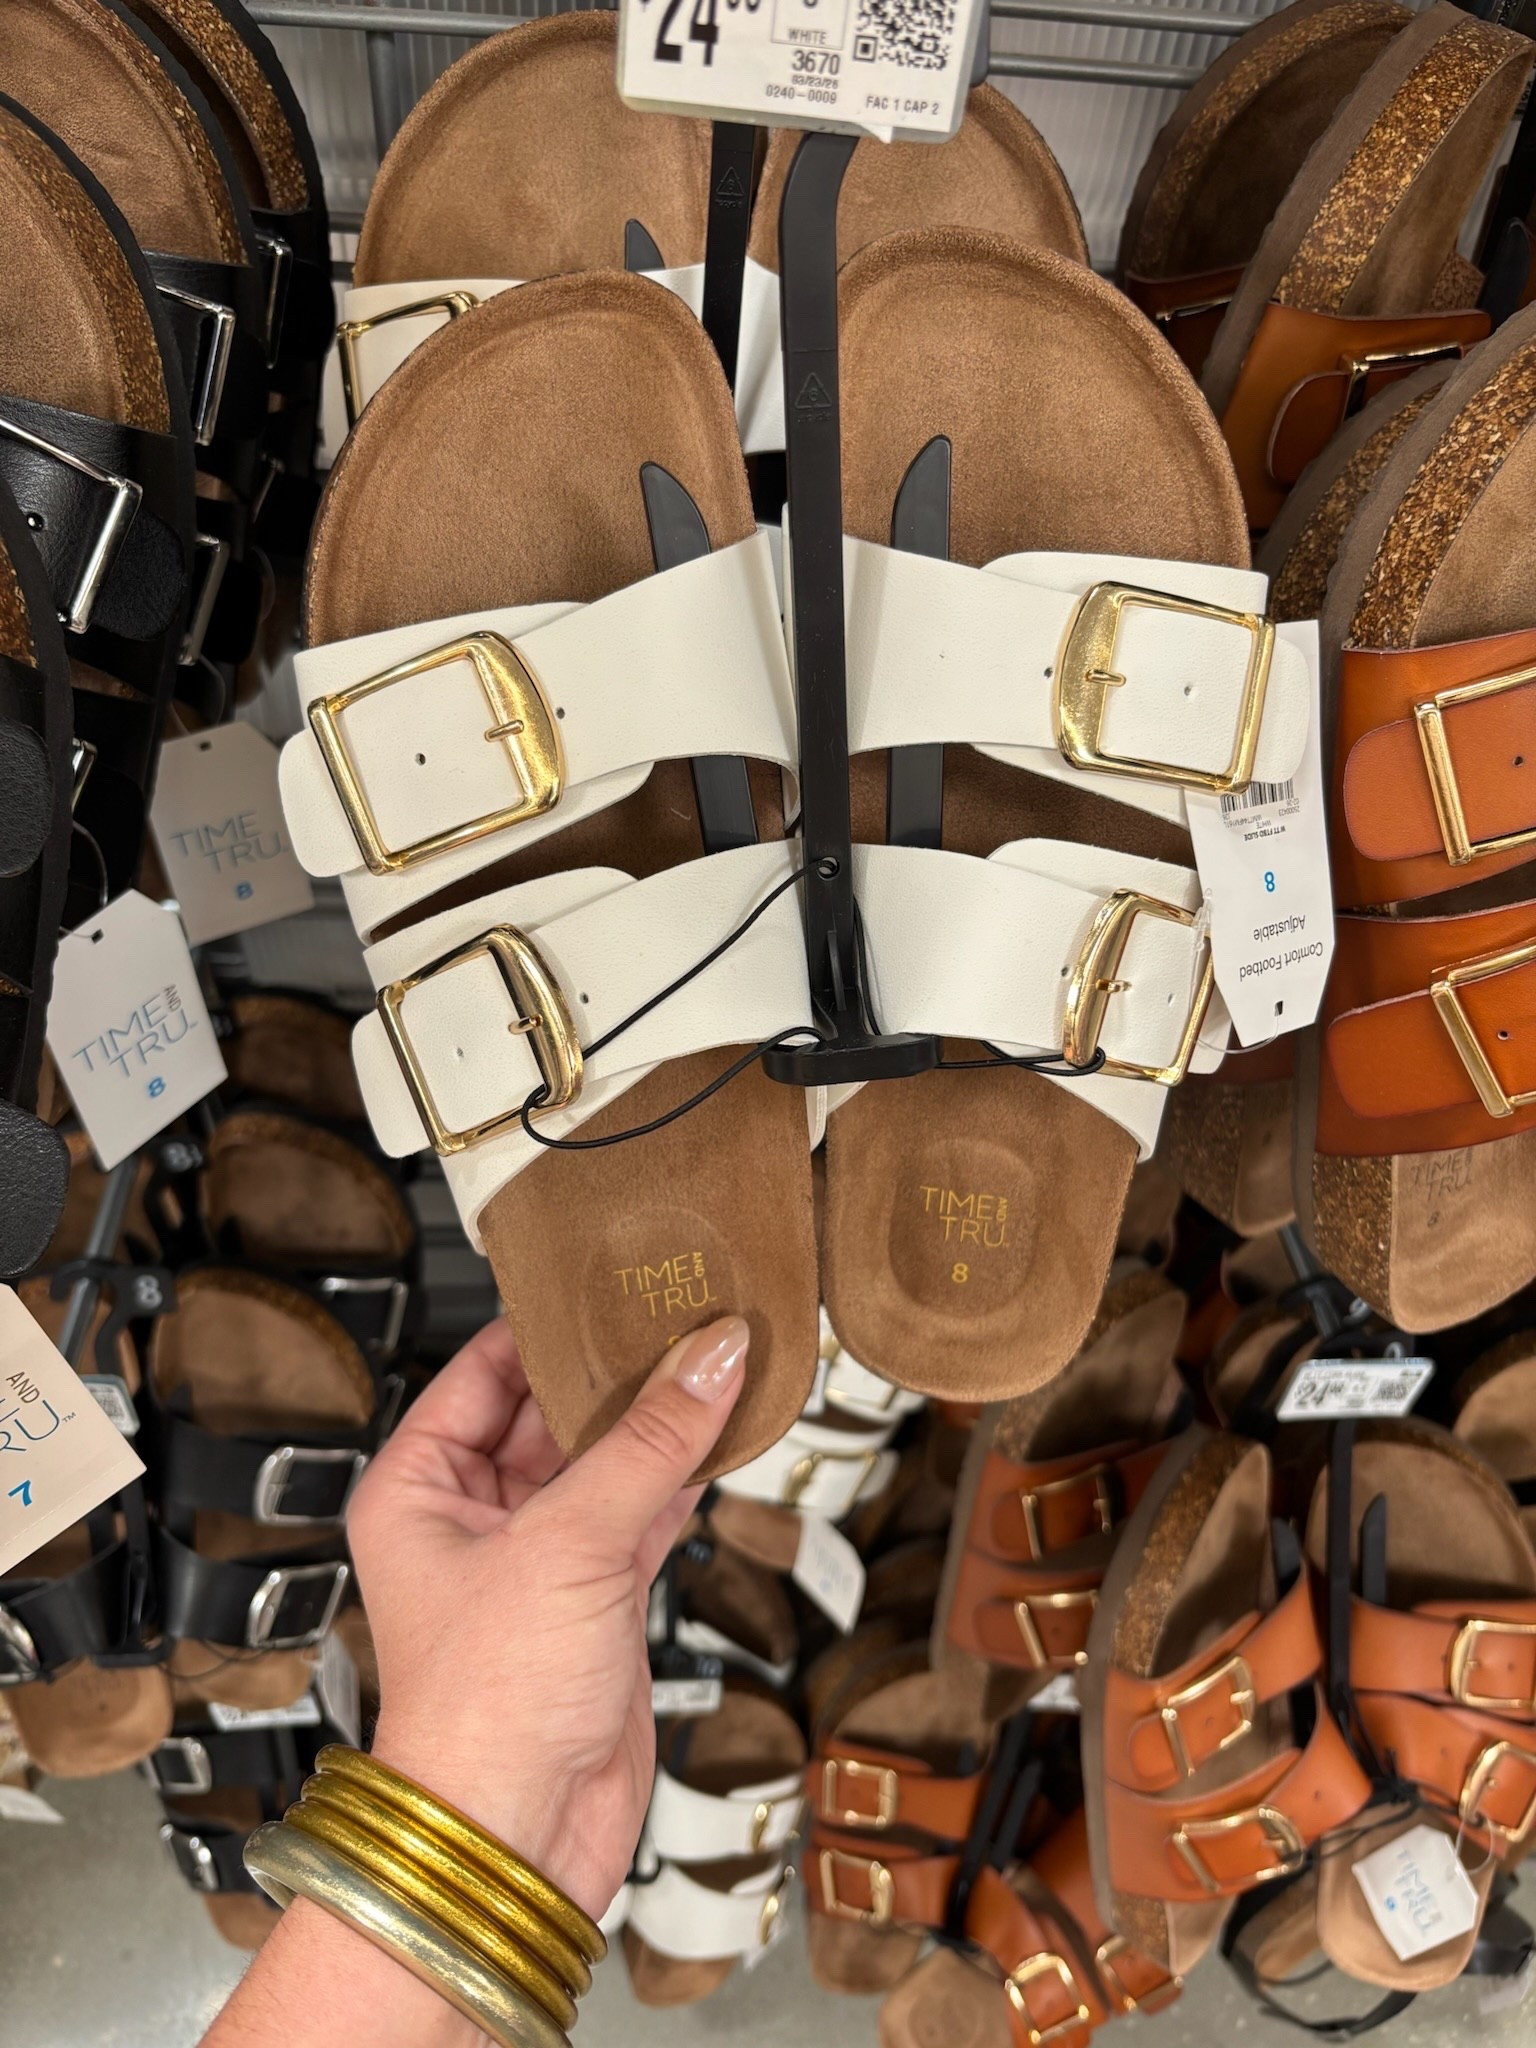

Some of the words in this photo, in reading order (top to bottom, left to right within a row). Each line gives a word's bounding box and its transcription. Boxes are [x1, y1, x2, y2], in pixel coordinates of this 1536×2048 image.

[787, 28, 827, 45] WHITE
[791, 50, 841, 76] 3670
[865, 96, 889, 111] FAC
[894, 100, 900, 112] 1
[903, 101, 927, 114] CAP
[931, 103, 941, 116] 2
[169, 811, 261, 859] TIME
[1263, 871, 1276, 893] 8
[1252, 915, 1306, 941] Adjustable
[1285, 942, 1324, 966] Comfort
[1239, 954, 1283, 982] Footbed
[72, 993, 168, 1073] TIME
[163, 984, 183, 1012] AND
[147, 1077, 166, 1098] 8
[920, 1185, 995, 1221] TIME
[614, 1254, 692, 1296] TIME
[951, 1263, 969, 1284] 8
[133, 1275, 163, 1309] 8
[6, 1371, 41, 1404] AND
[8, 1480, 34, 1508] 7
